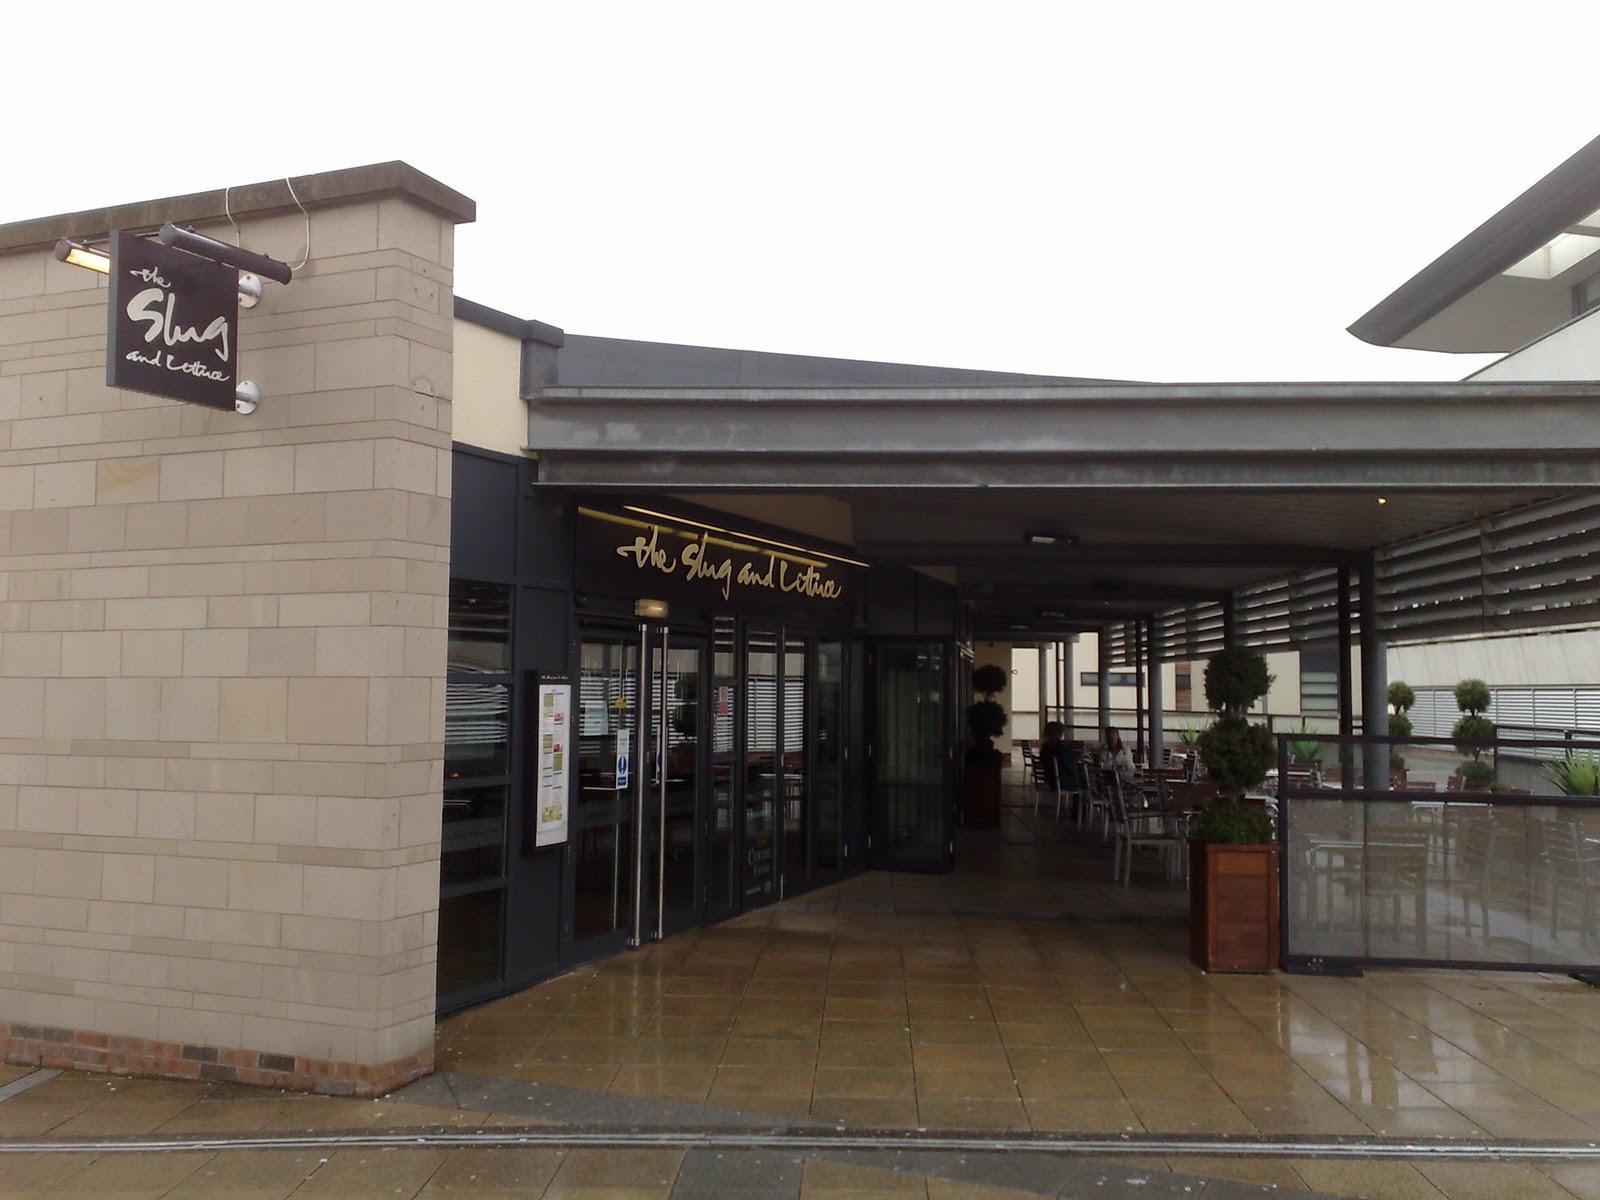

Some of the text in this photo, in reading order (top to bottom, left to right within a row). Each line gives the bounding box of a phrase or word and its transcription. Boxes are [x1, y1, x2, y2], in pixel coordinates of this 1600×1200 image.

[129, 266, 171, 287] the
[127, 287, 229, 362] Slug
[125, 350, 161, 367] and
[616, 525, 677, 573] the
[681, 531, 732, 601] Slug
[737, 555, 775, 589] and
